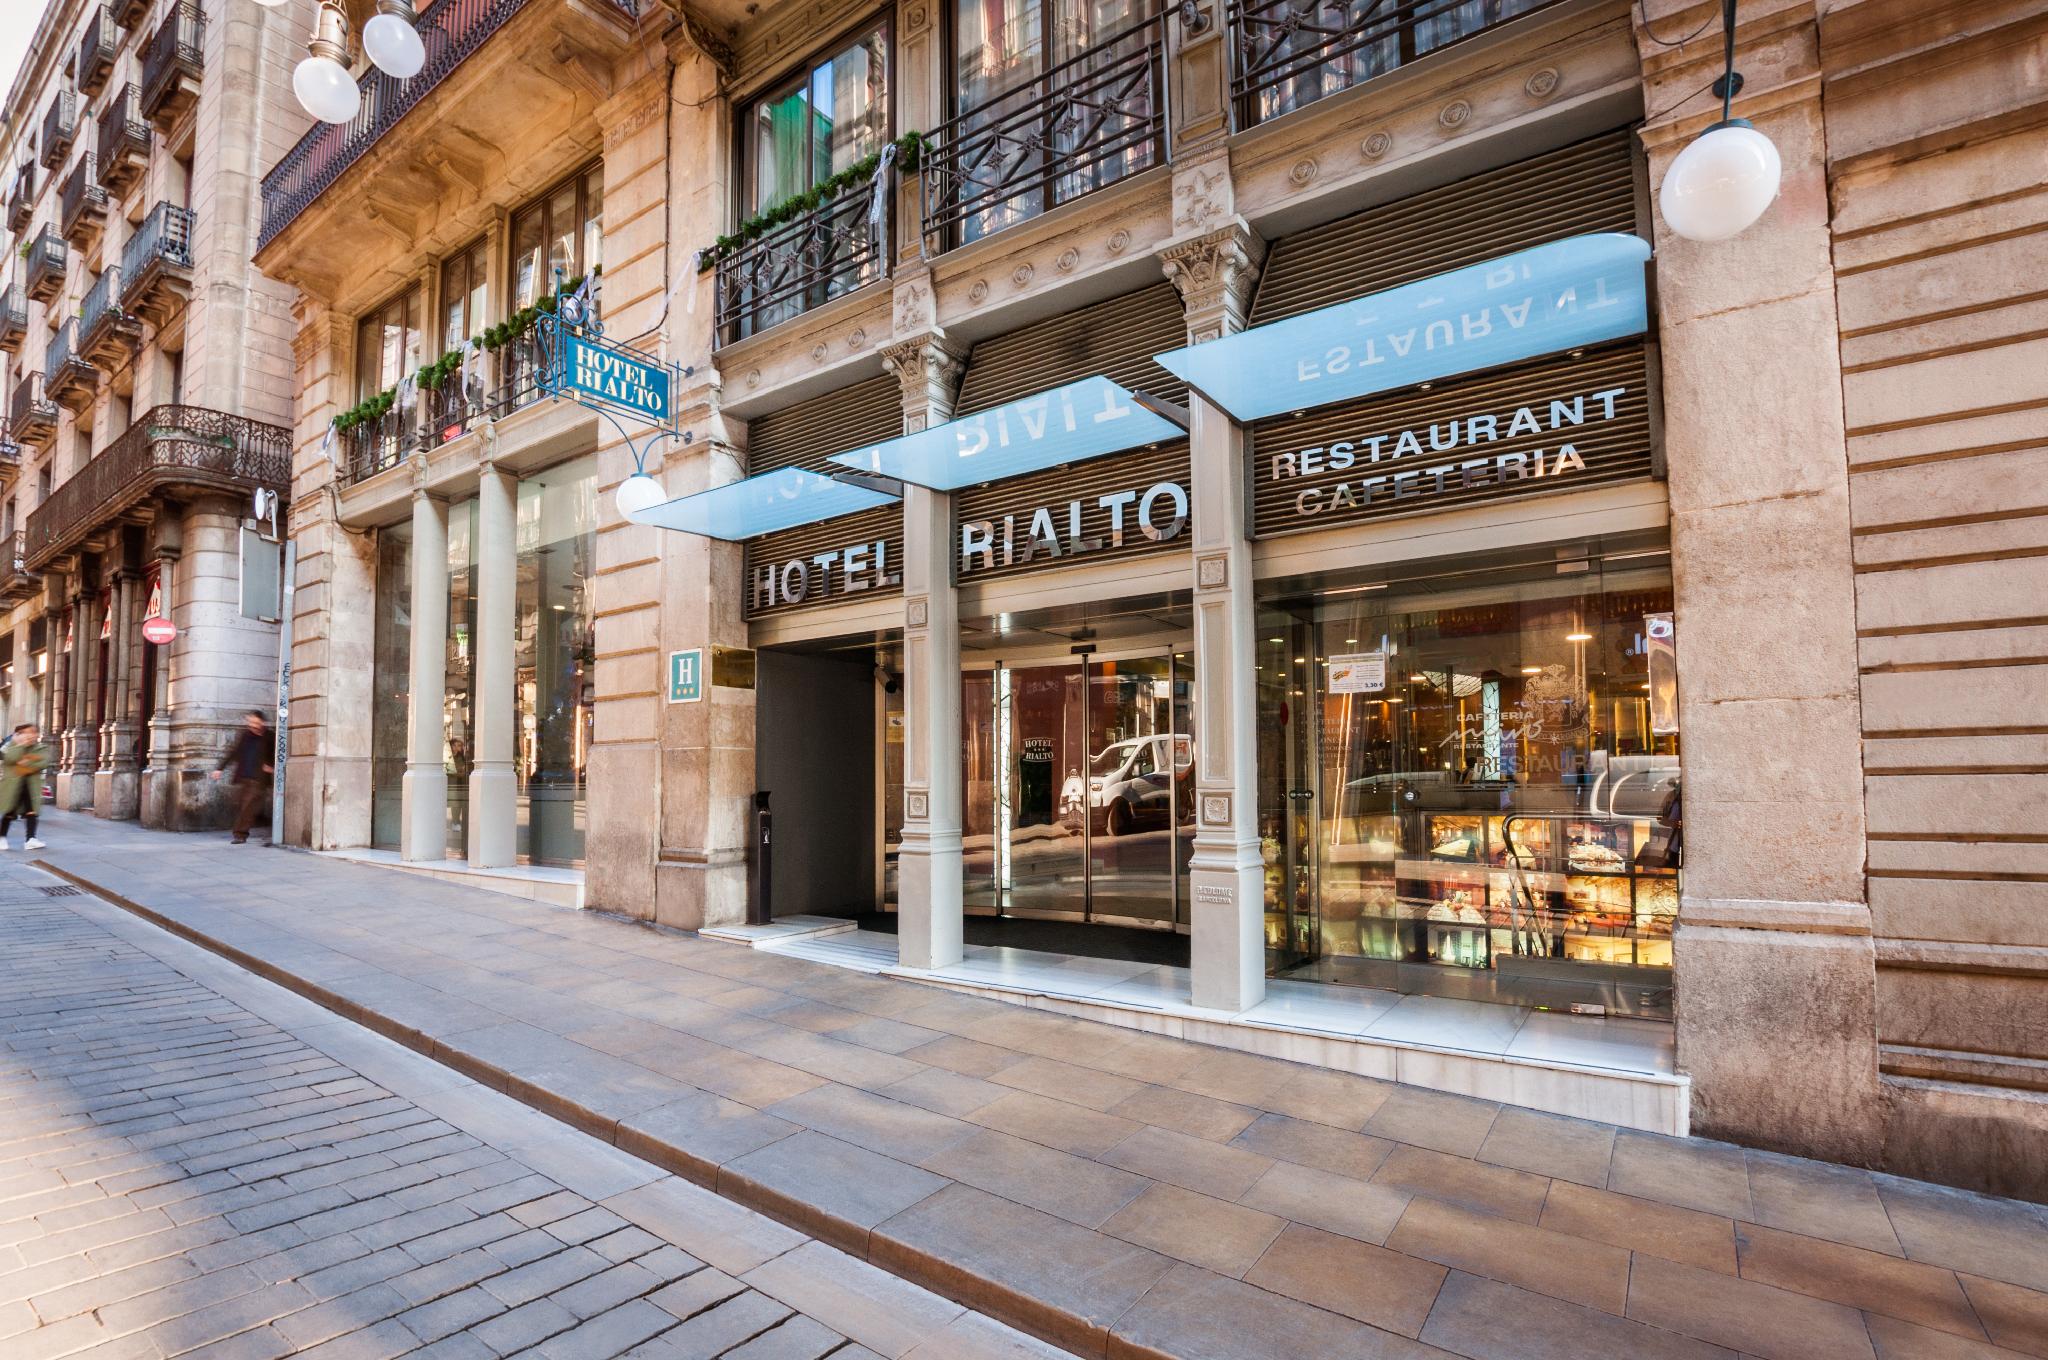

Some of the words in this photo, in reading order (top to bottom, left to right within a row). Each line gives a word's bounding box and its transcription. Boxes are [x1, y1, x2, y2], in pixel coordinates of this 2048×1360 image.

[577, 343, 653, 390] HOTEL
[577, 365, 662, 411] RIALTO
[1271, 387, 1626, 480] RESTAURANT
[1295, 443, 1587, 517] CAFETERIA
[753, 541, 901, 609] HOTEL
[962, 482, 1189, 572] RIALTO
[678, 657, 693, 685] H
[1025, 739, 1054, 748] HOTEL
[1025, 752, 1055, 760] RIALTO
